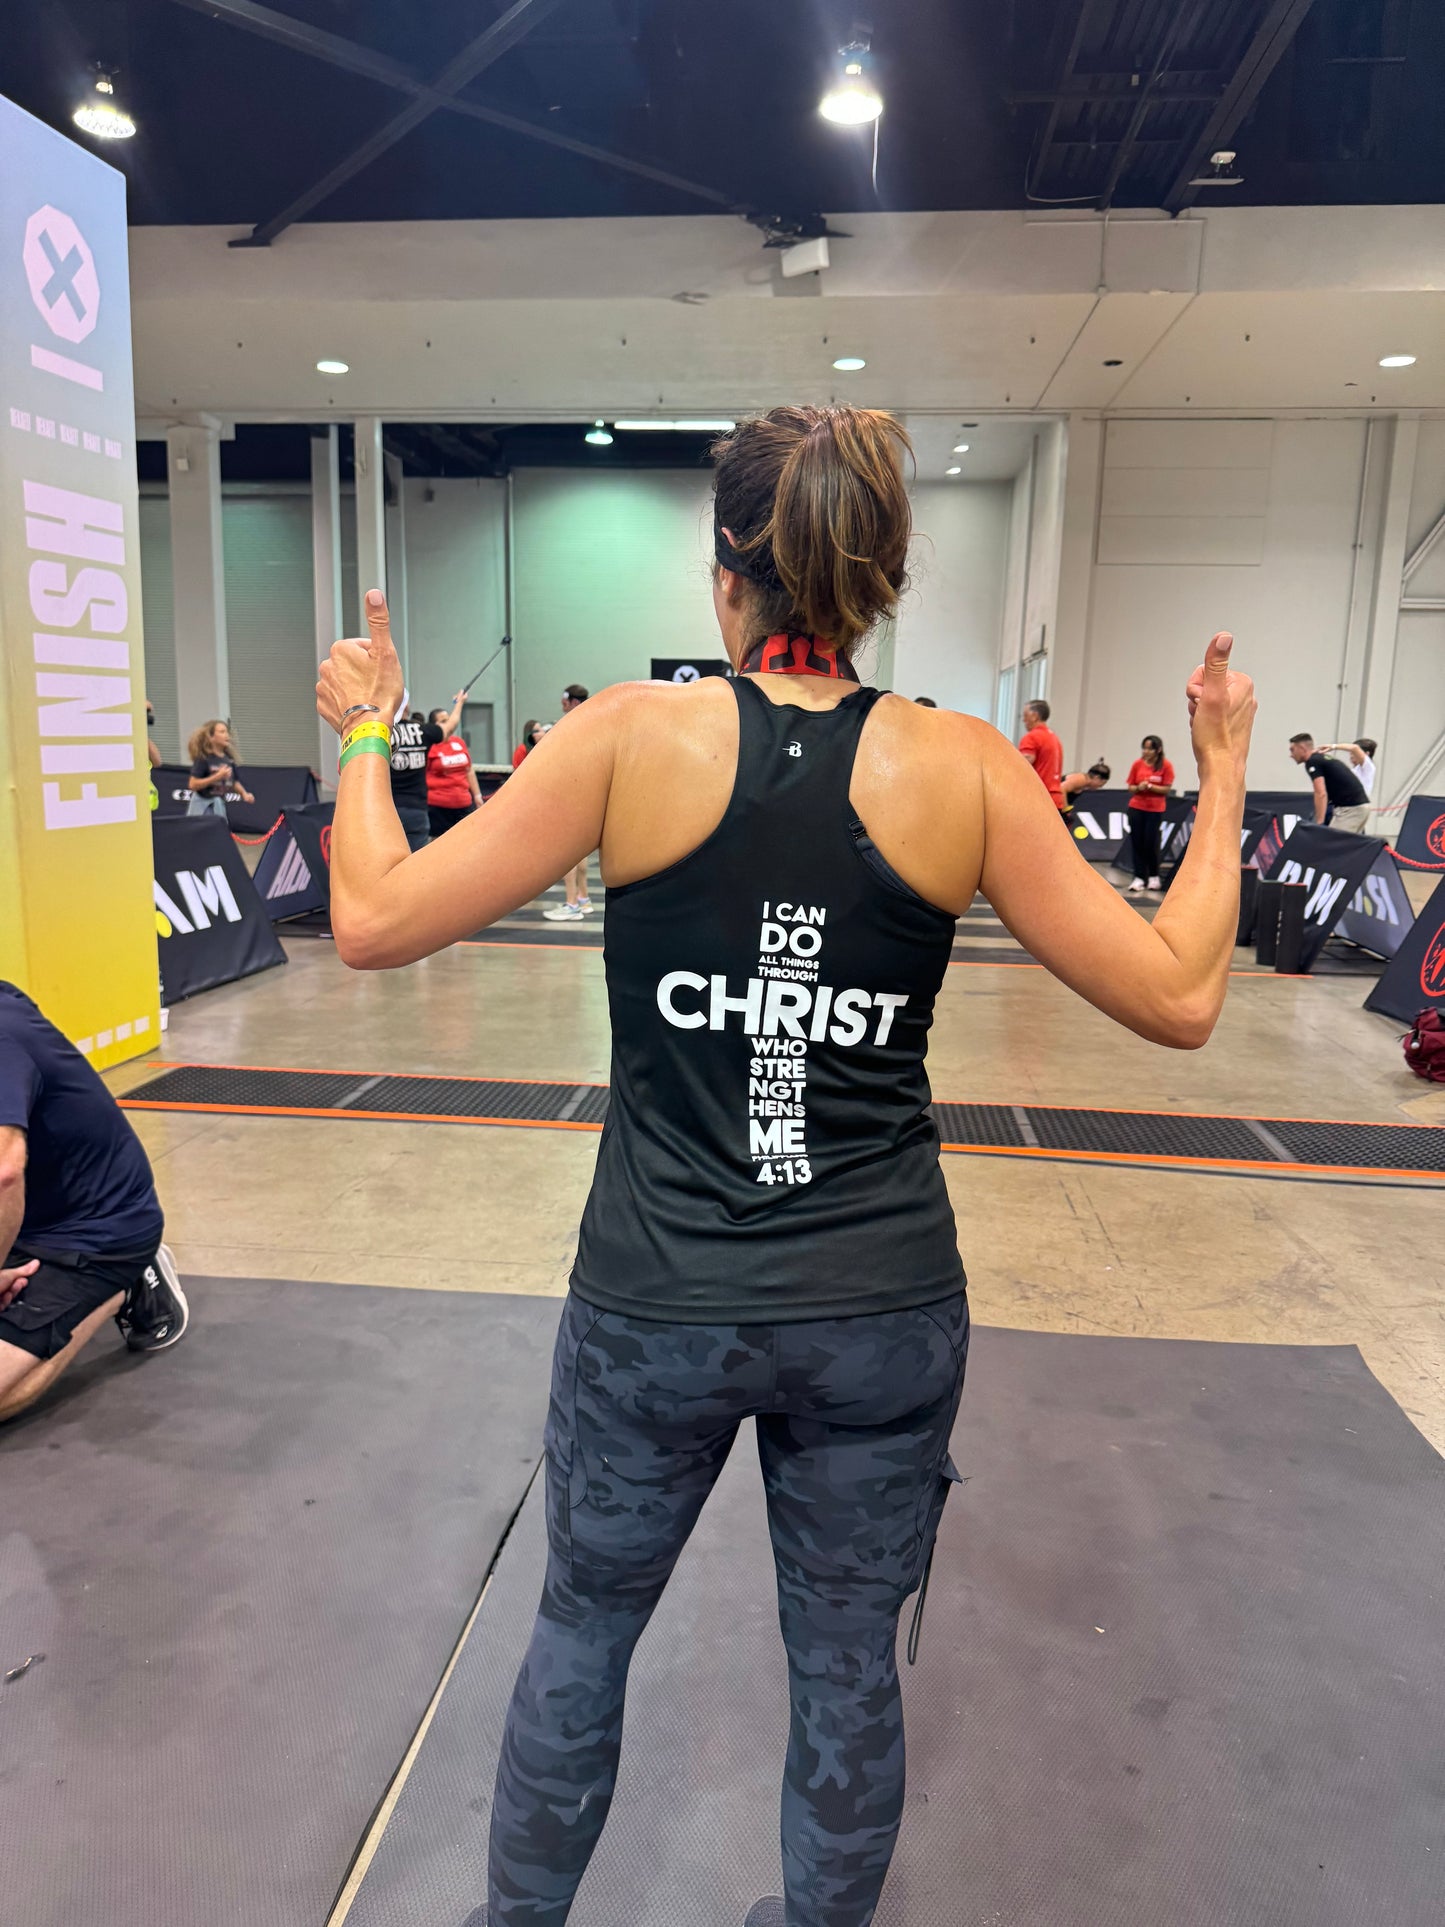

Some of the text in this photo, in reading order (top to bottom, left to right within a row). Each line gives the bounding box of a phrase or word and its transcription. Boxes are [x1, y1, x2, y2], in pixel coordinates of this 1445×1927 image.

[23, 479, 137, 829] FINISH
[392, 722, 424, 746] AFF
[153, 865, 243, 935] AM
[763, 901, 826, 925] I CAN
[760, 922, 822, 957] DO
[758, 966, 818, 982] THROUGH
[759, 955, 819, 969] ALL THINGS
[657, 971, 909, 1046] CHRIST
[751, 1038, 807, 1056] WHO
[750, 1058, 806, 1078] STRE
[749, 1077, 806, 1102] NGT
[749, 1099, 805, 1117] HENS
[750, 1119, 806, 1155] ME
[757, 1159, 812, 1185] 4:13
